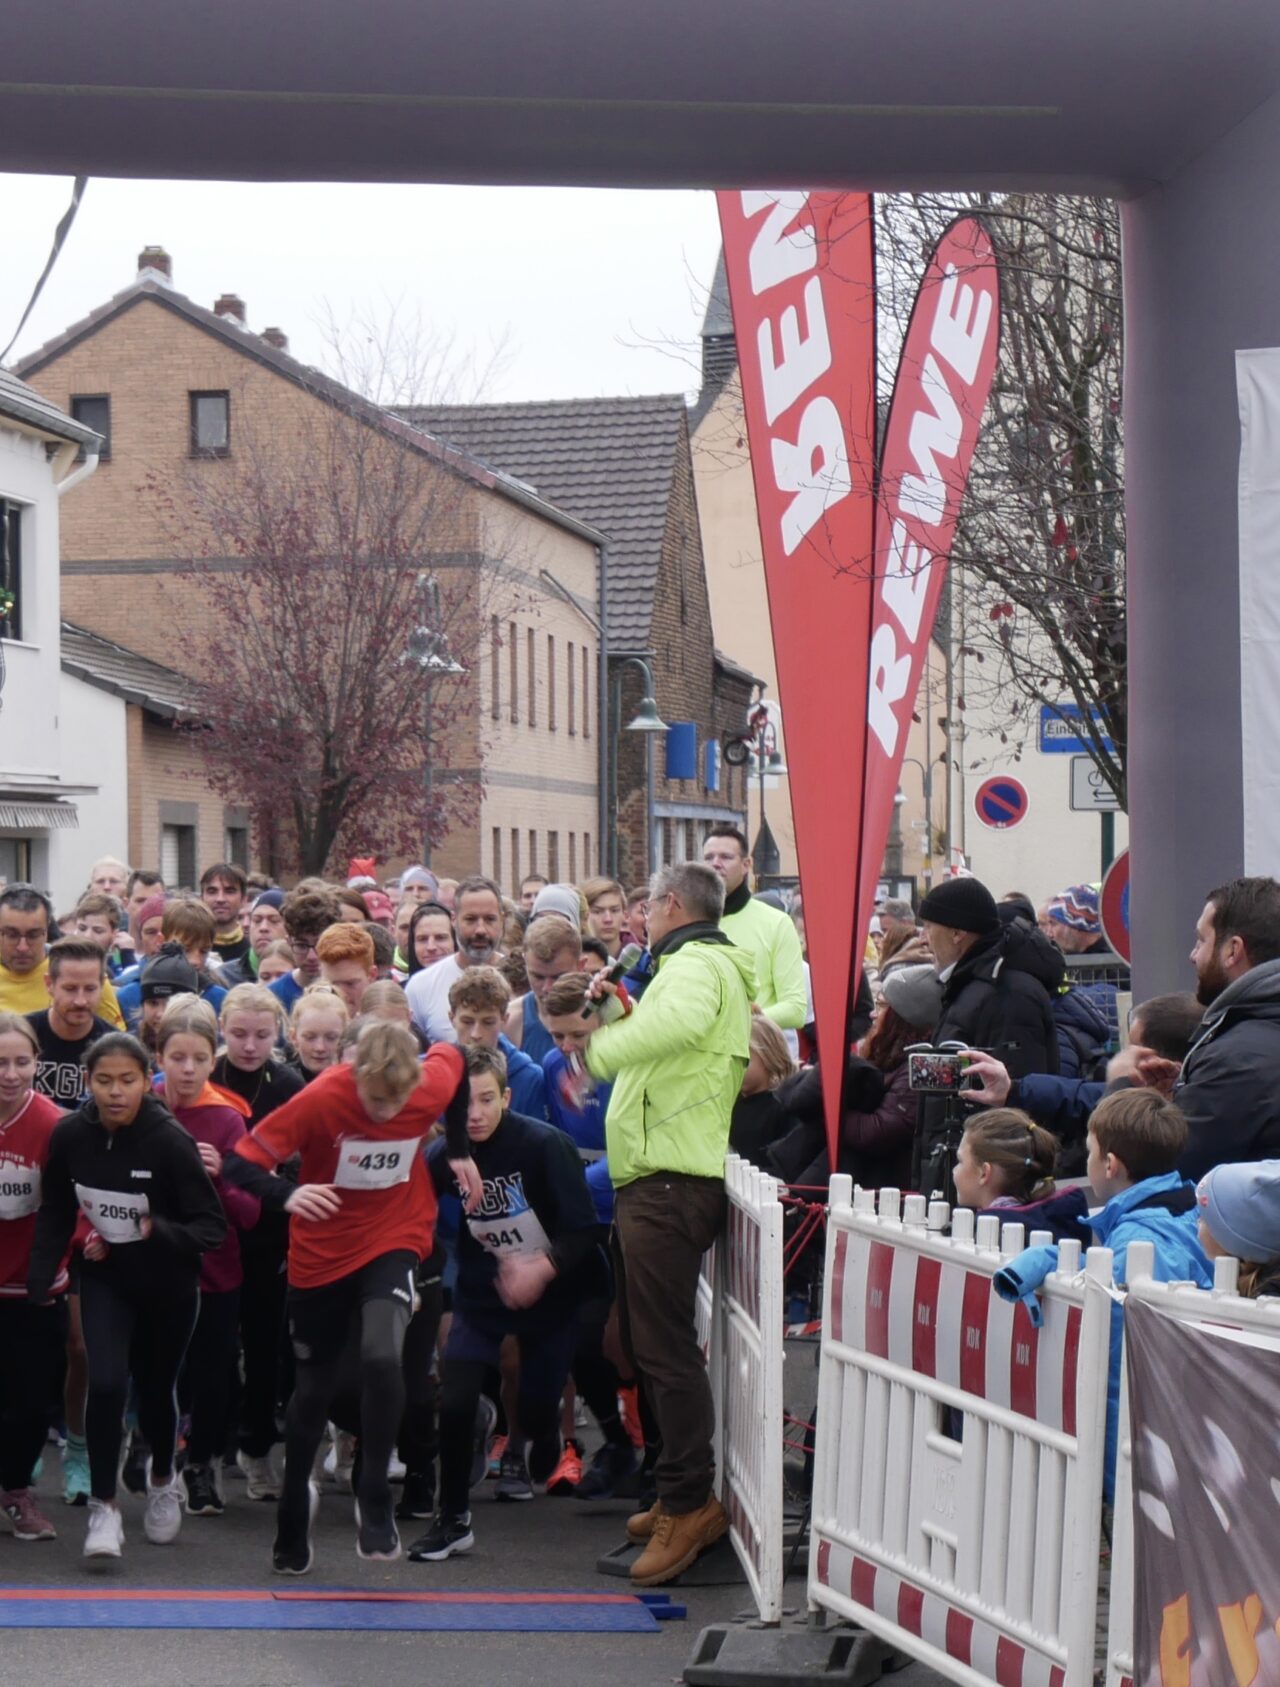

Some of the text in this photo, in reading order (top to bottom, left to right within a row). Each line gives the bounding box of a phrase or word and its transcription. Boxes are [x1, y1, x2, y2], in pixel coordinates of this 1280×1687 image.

[868, 262, 993, 758] REWE
[358, 1152, 400, 1170] 439
[99, 1203, 139, 1220] 2056
[486, 1228, 524, 1247] 941
